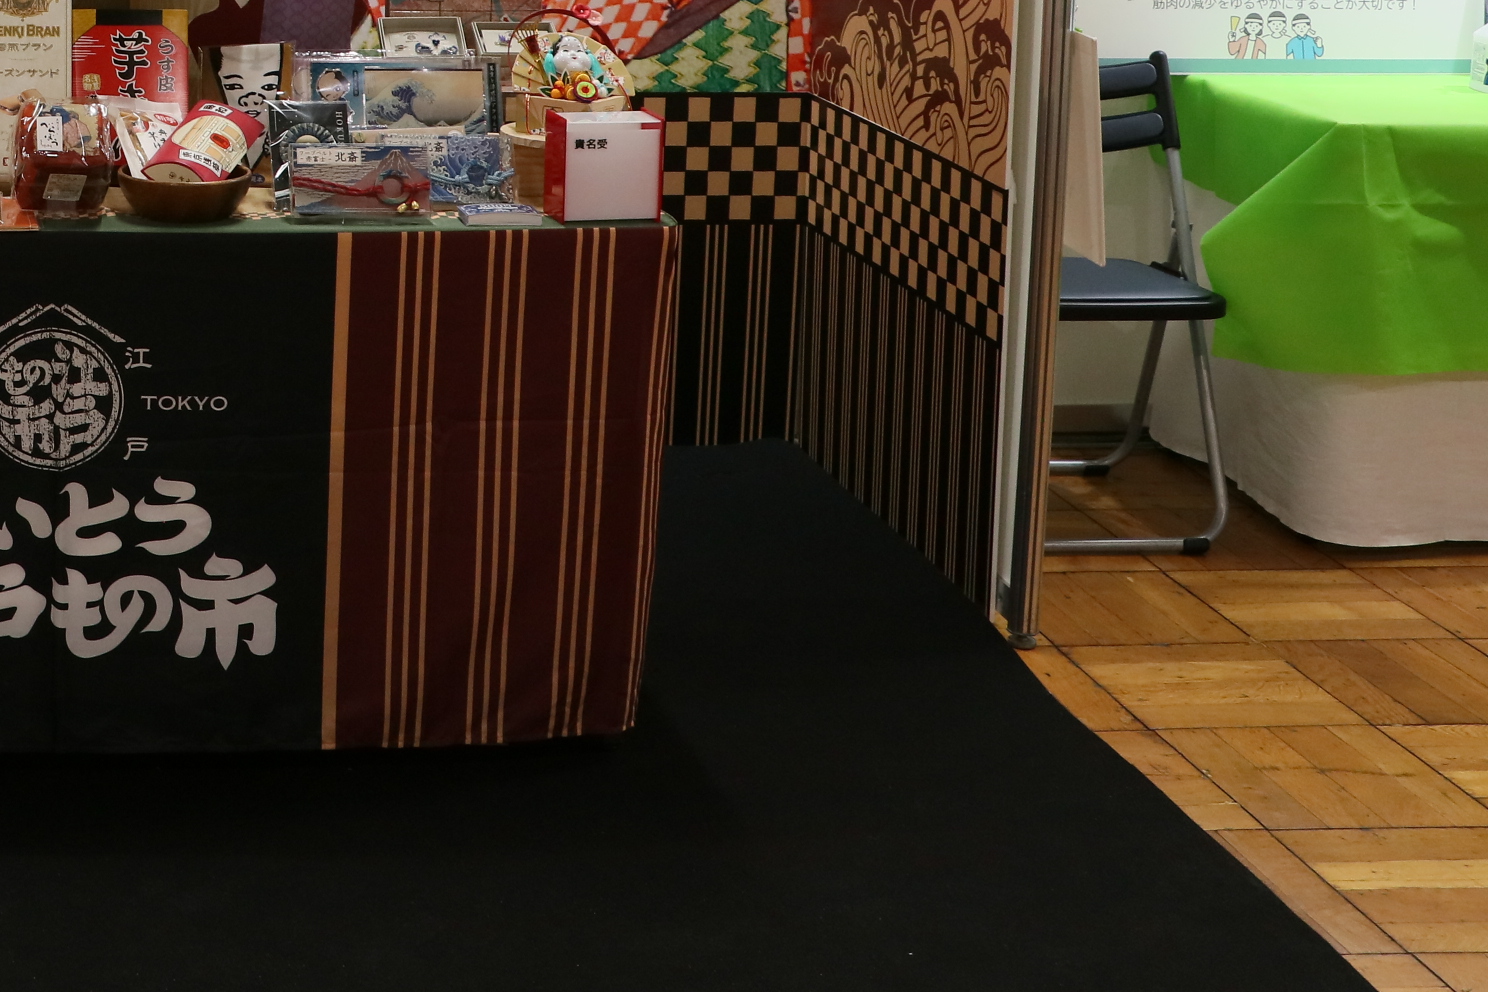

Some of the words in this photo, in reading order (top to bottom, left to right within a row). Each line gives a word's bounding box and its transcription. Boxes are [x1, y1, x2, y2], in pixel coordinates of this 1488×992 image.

[27, 24, 61, 38] BRAN
[157, 38, 176, 92] うす皮
[574, 138, 607, 149] 貴名受
[334, 150, 359, 163] 北斎
[124, 346, 153, 369] 江
[140, 395, 228, 412] TOKYO
[123, 436, 150, 460] 戸
